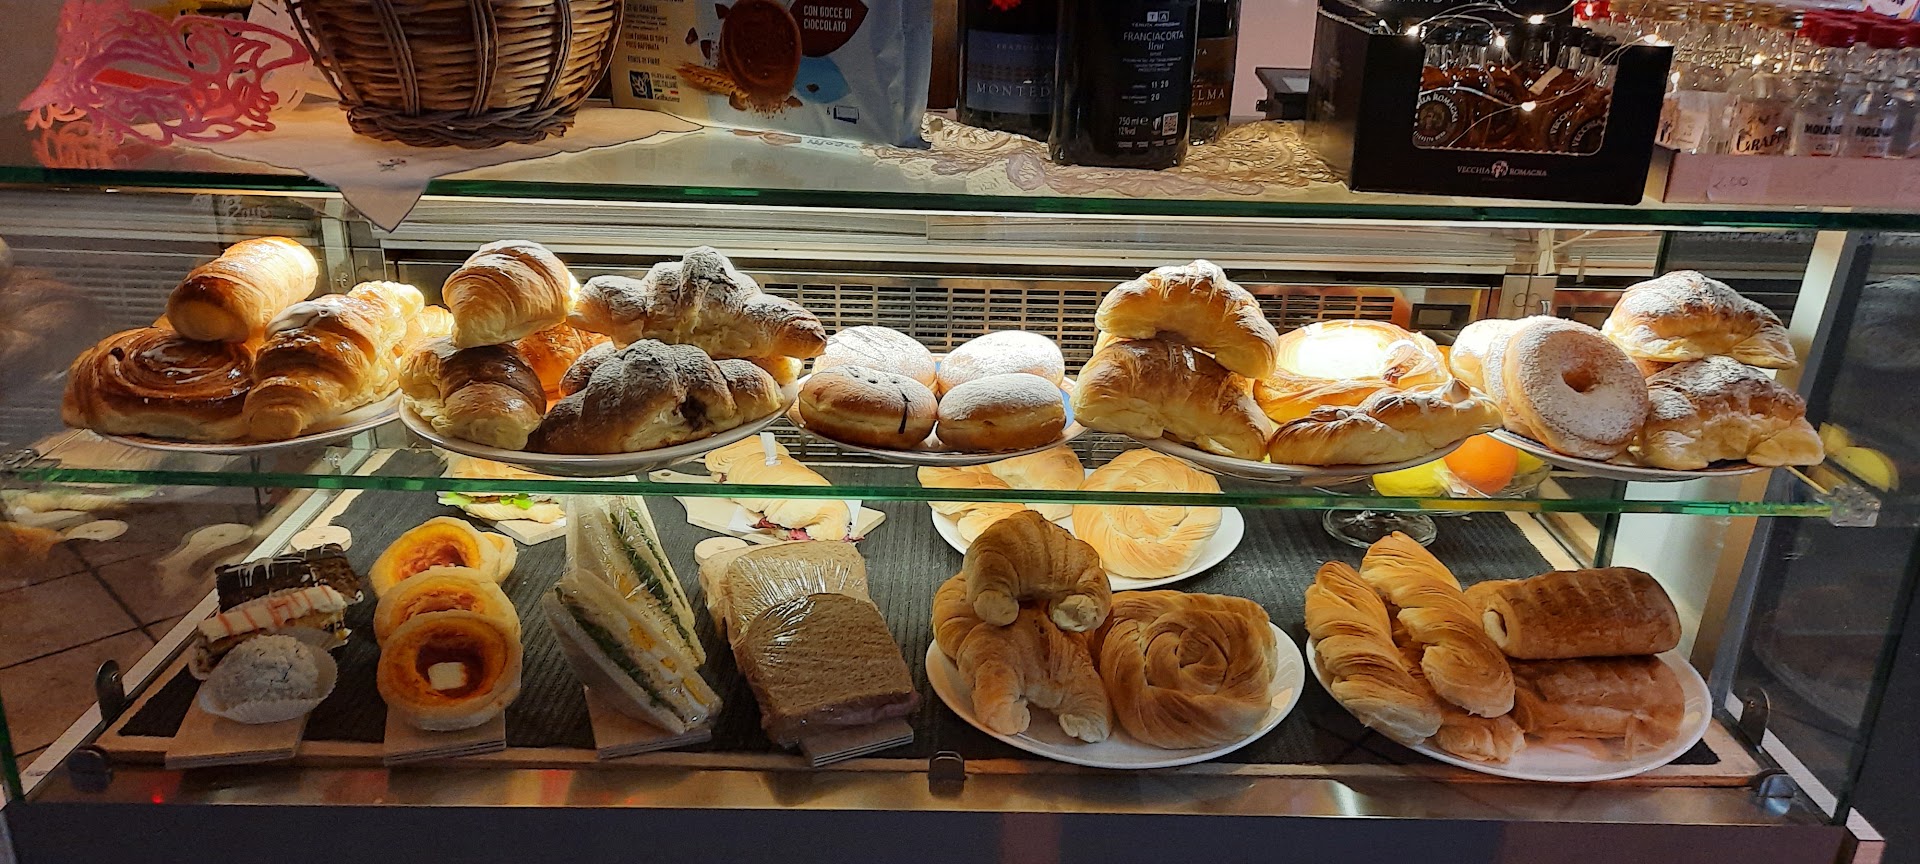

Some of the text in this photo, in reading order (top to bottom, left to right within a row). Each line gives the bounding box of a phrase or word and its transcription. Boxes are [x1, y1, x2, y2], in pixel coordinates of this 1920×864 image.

[803, 5, 818, 16] CON
[844, 8, 852, 19] DI
[803, 18, 847, 32] CIOCCOLATO
[1123, 30, 1184, 41] FRANCIACORTA
[1151, 92, 1160, 101] 20
[1119, 116, 1131, 126] 750
[1457, 166, 1548, 177] VECCHIA ROMAGNA
